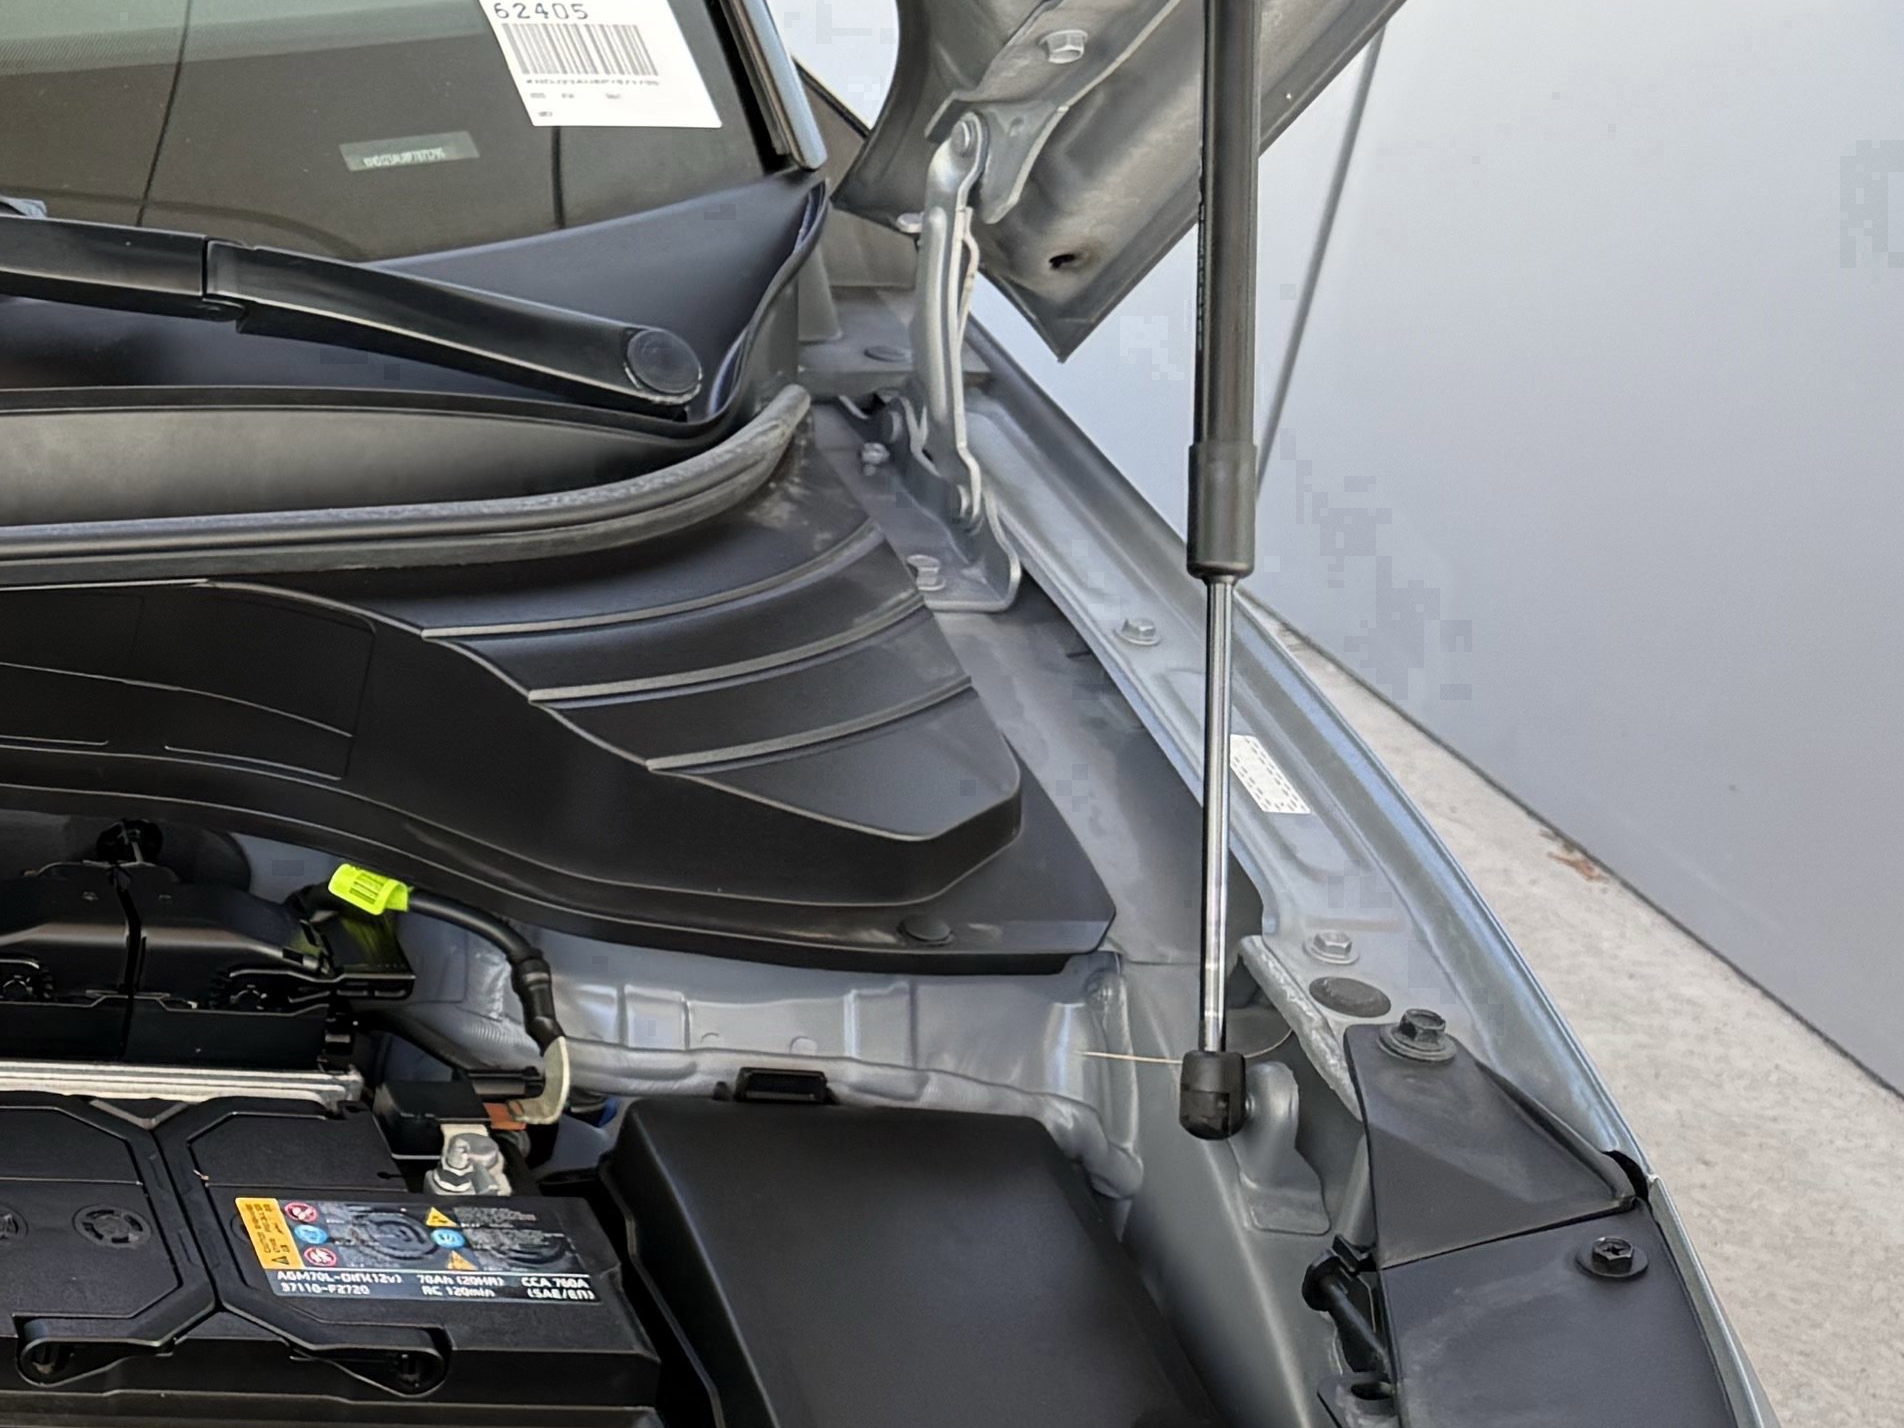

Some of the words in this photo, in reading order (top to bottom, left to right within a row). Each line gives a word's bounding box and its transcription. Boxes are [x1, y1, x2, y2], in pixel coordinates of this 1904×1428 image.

[494, 2, 589, 20] 62405
[417, 1274, 454, 1285] 70Ah
[521, 1277, 552, 1288] CCA
[421, 1285, 442, 1296] RC
